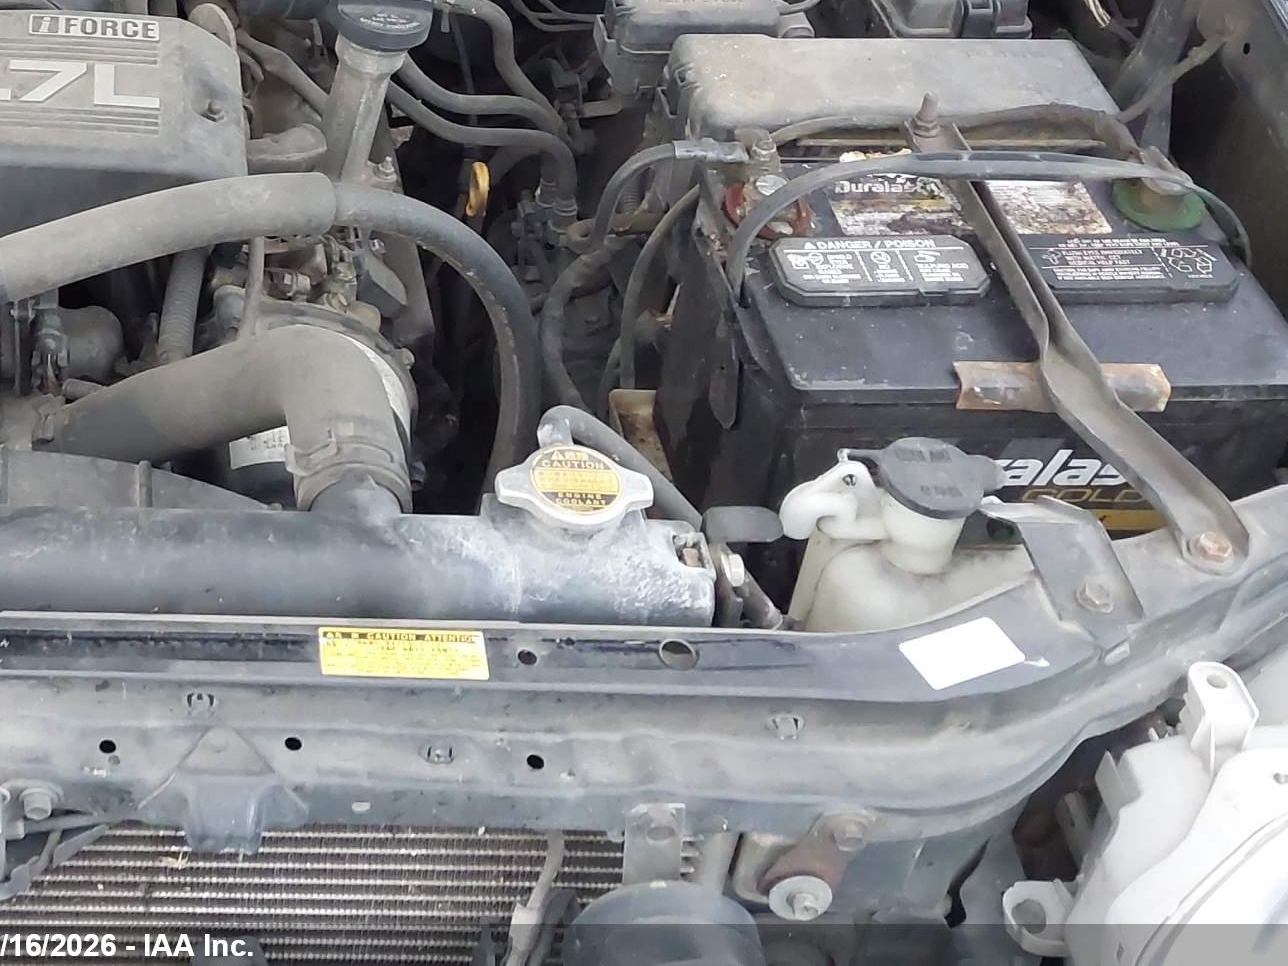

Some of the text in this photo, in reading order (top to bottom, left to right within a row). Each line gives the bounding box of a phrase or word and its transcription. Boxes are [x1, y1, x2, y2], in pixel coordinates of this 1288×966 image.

[816, 240, 873, 250] DANGER
[883, 239, 937, 249] POISON
[542, 460, 604, 469] CAUTION
[557, 492, 602, 500] ENGINE
[1021, 488, 1144, 502] GOLD
[555, 498, 607, 506] COOLANT
[366, 632, 417, 642] CAUTION
